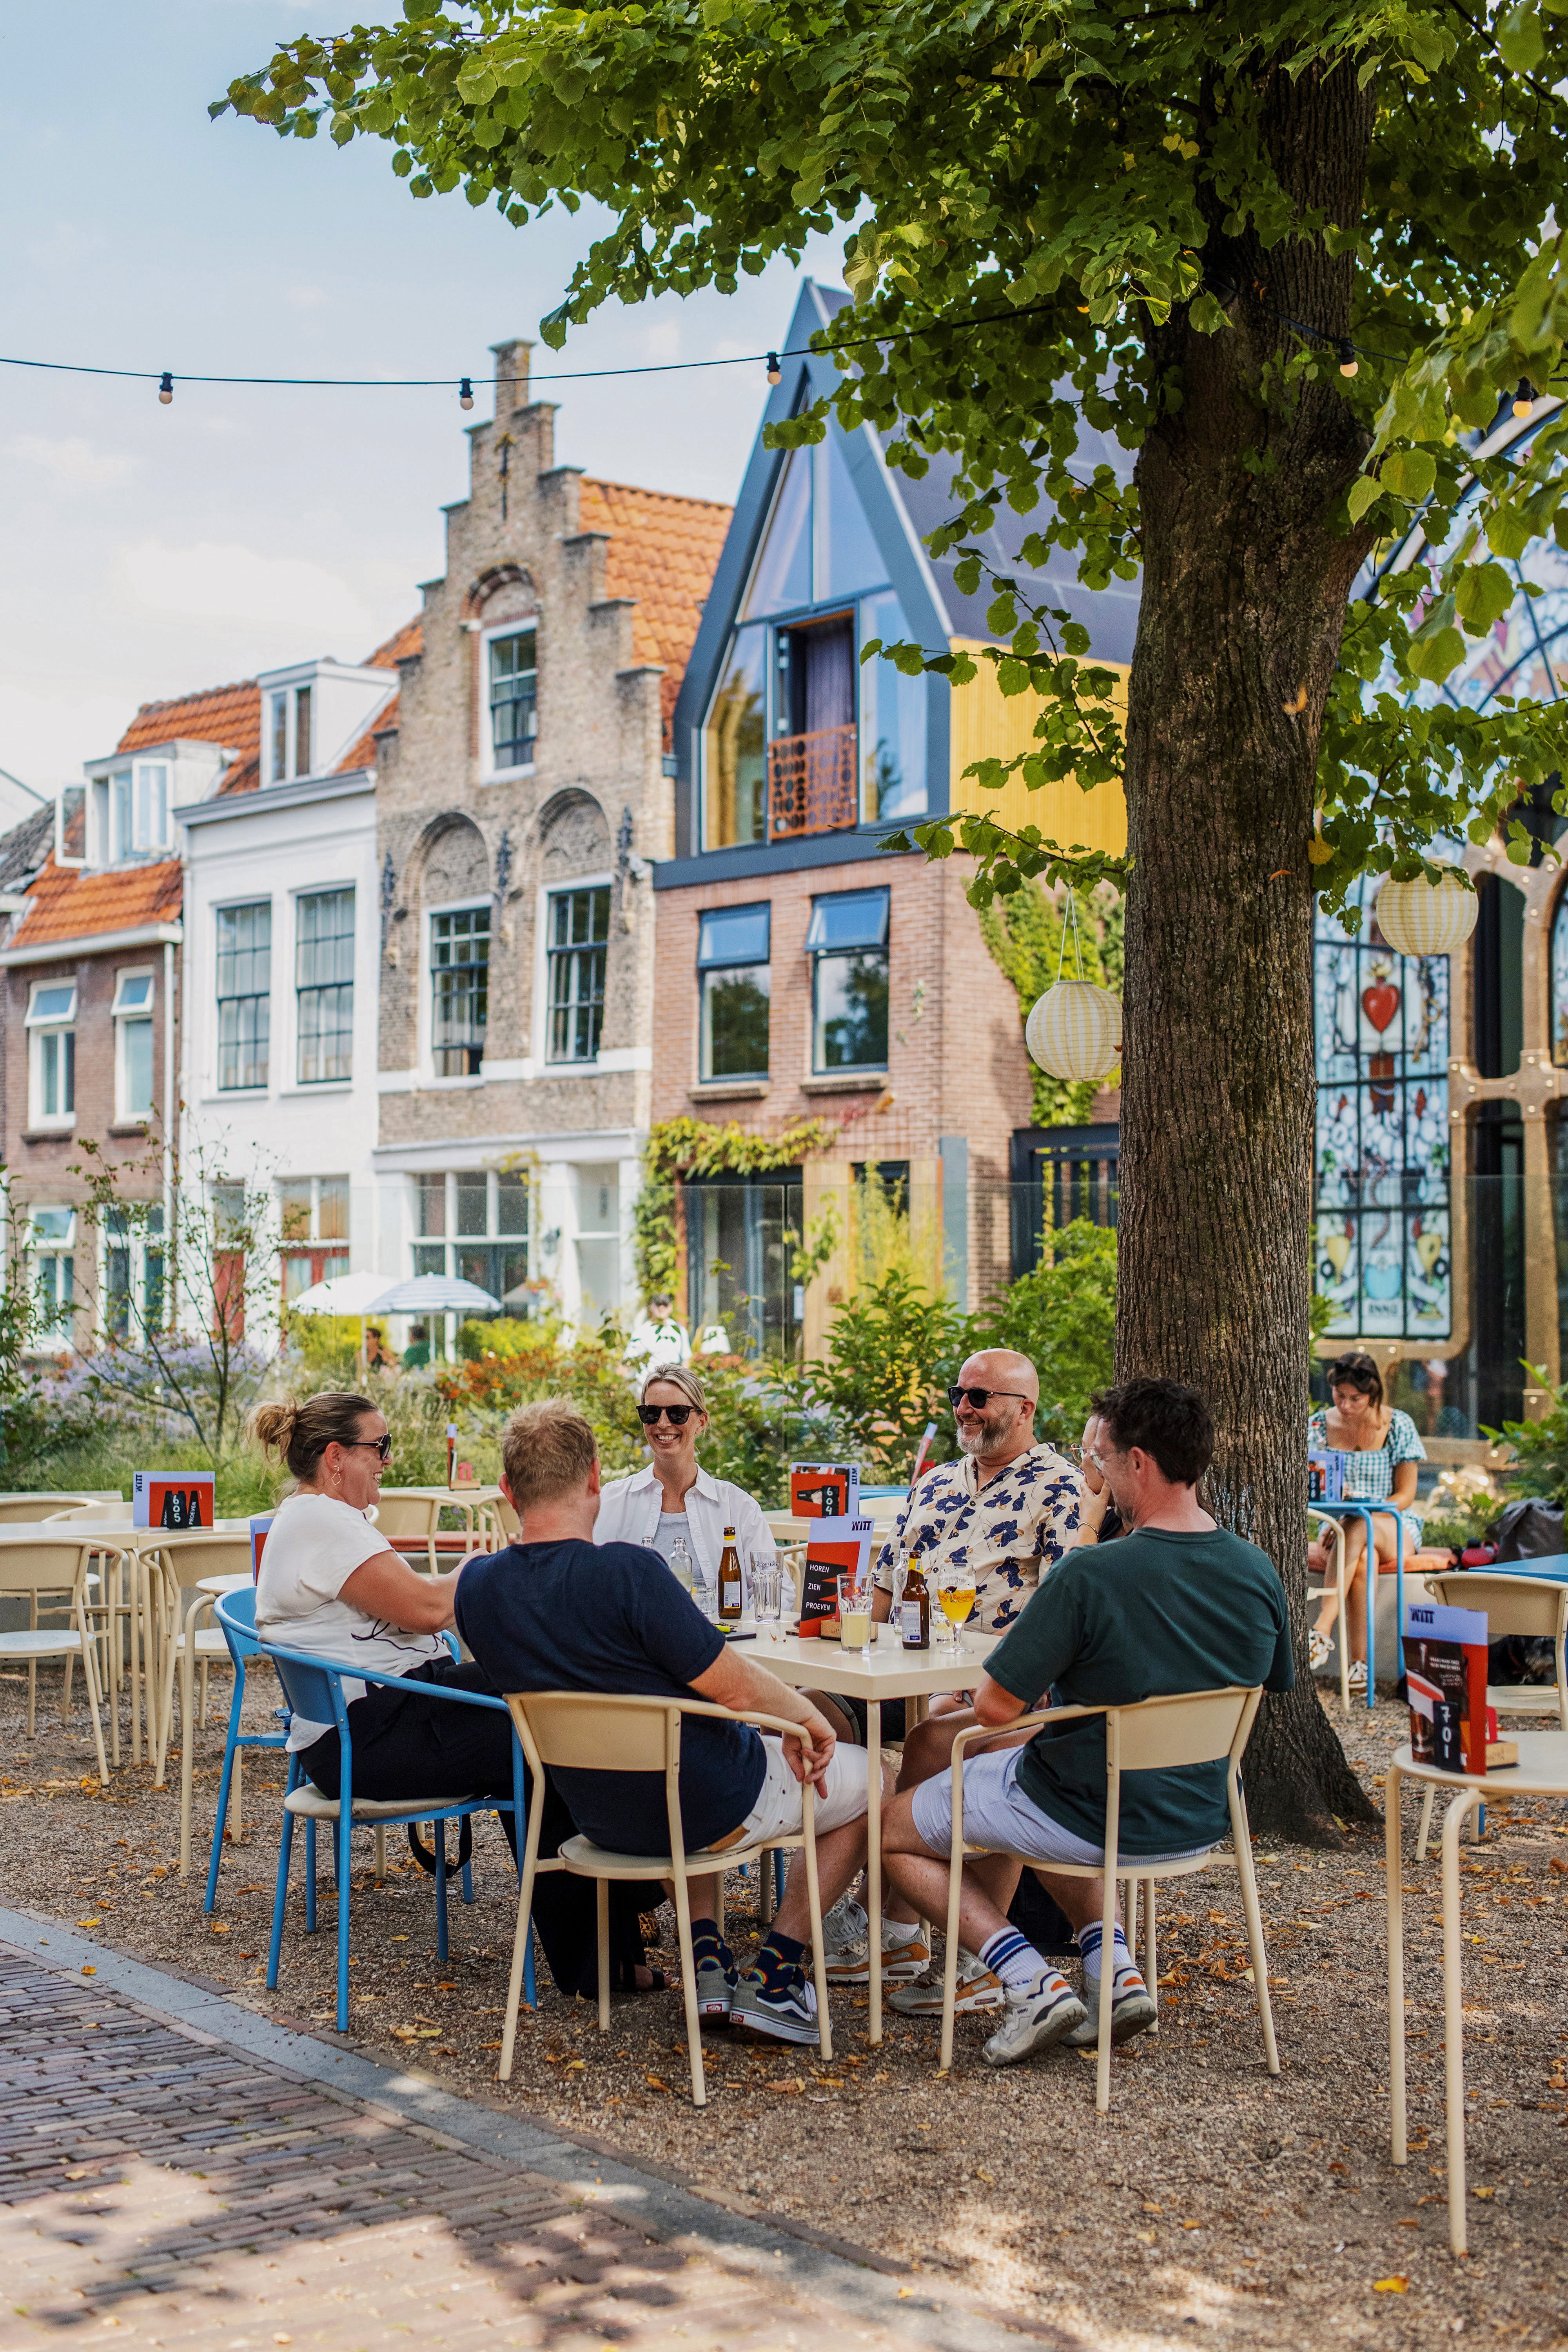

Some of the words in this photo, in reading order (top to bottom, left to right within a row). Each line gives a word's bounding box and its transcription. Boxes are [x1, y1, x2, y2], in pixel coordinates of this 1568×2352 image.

[825, 1487, 833, 1515] 604
[172, 1495, 181, 1523] 605
[851, 1521, 872, 1531] WITT
[809, 1564, 829, 1573] HOREN
[808, 1583, 821, 1591] ZIEN
[806, 1602, 831, 1611] PROEVEN
[1440, 1706, 1452, 1759] 701
